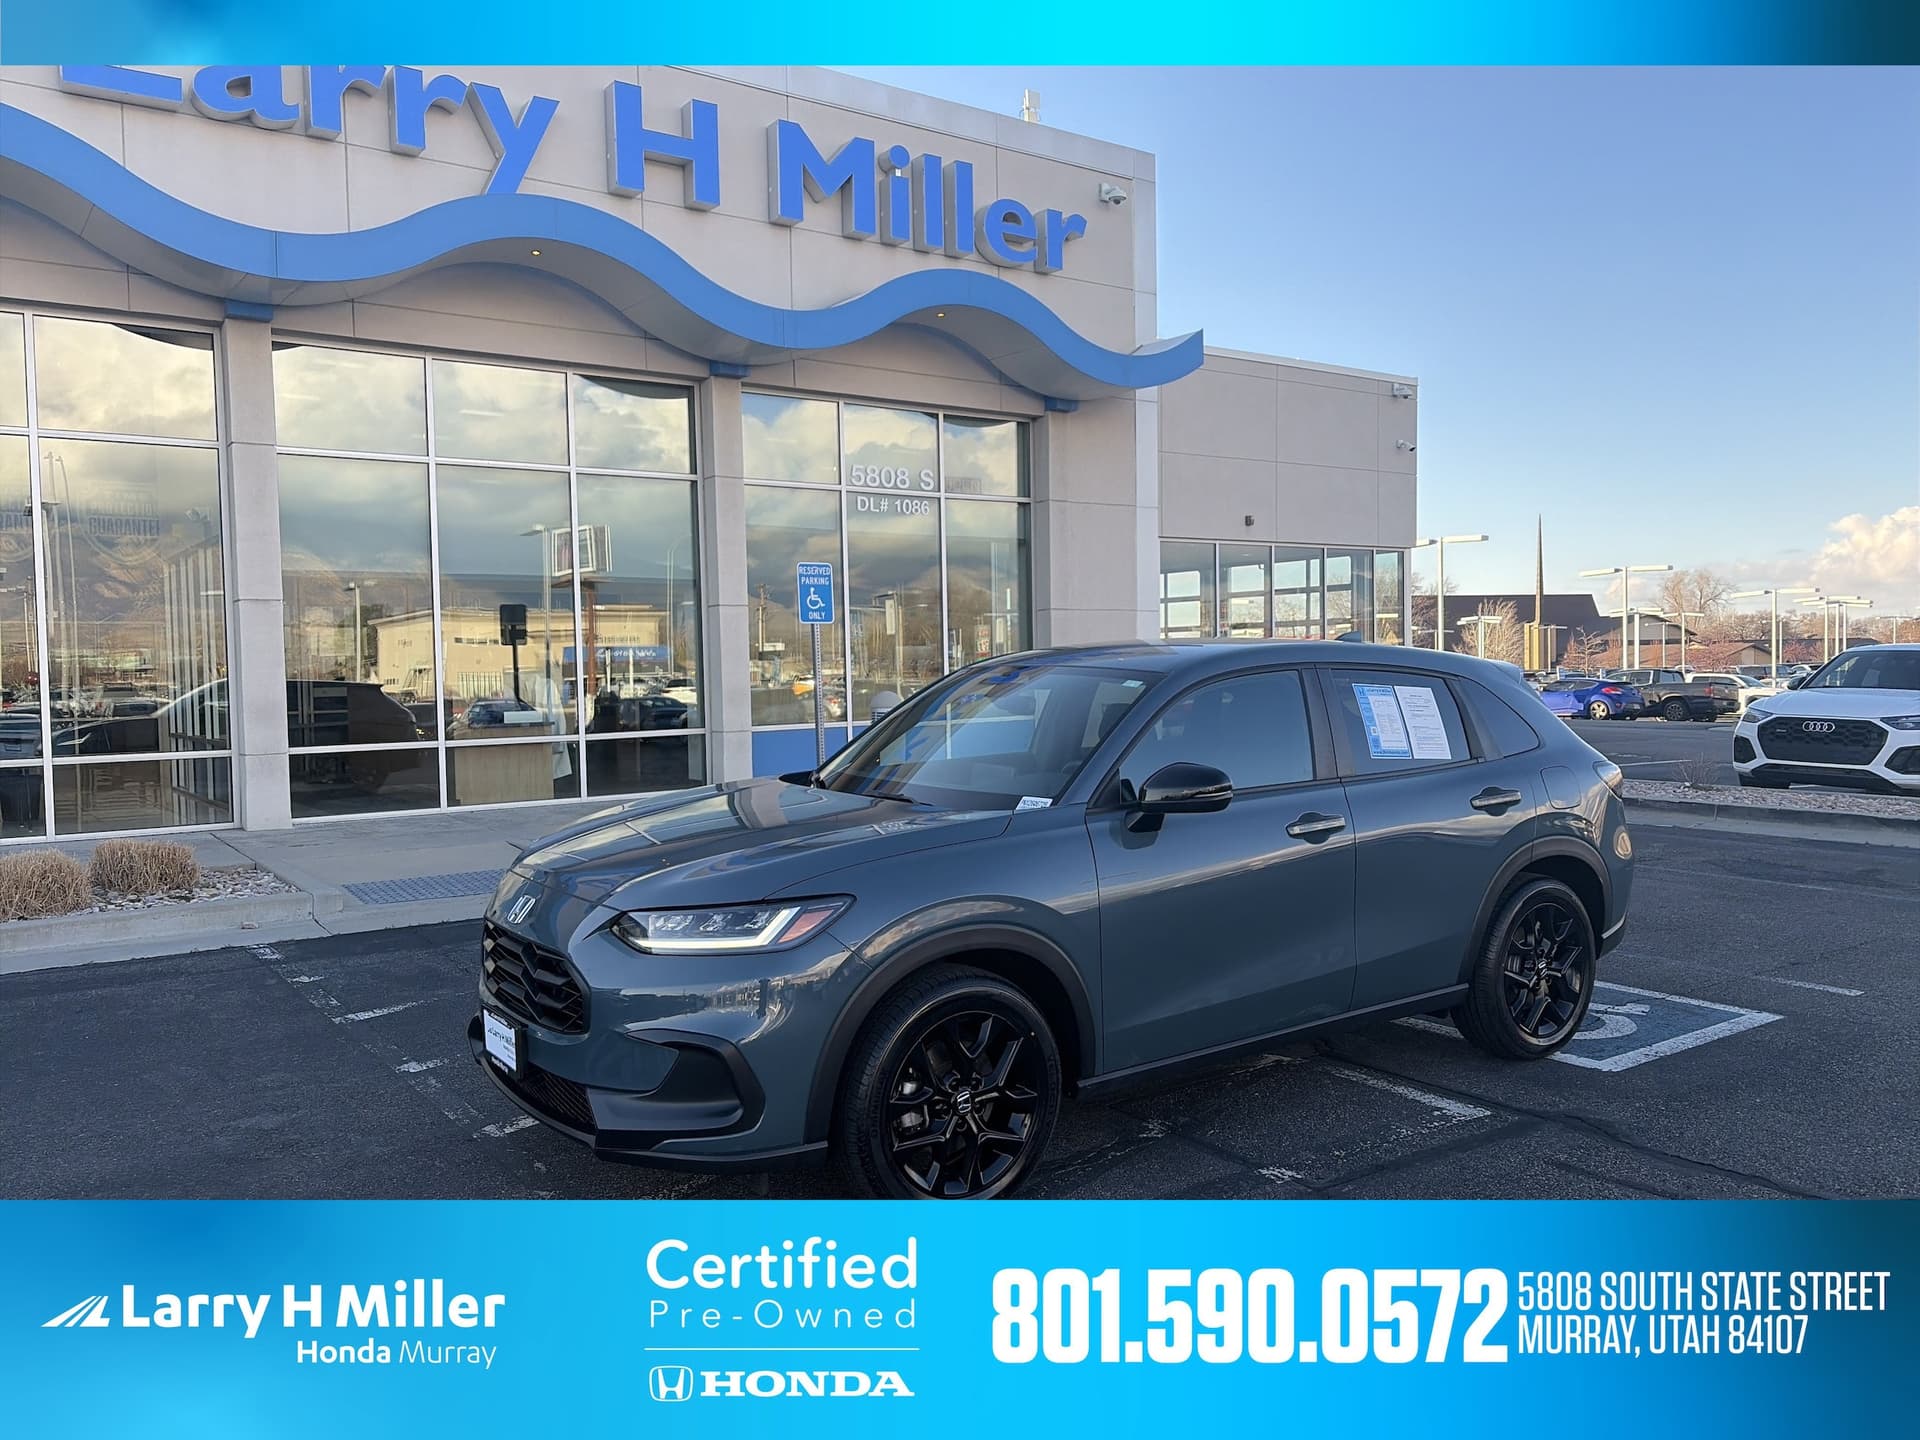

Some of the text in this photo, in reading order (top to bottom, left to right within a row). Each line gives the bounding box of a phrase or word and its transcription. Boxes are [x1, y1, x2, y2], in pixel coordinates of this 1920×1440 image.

[605, 80, 720, 211] H
[767, 118, 1087, 274] Miller
[851, 464, 910, 489] 5808
[919, 469, 935, 491] S
[857, 496, 930, 515] DL# 1086
[799, 566, 831, 576] RESERVED
[801, 577, 830, 585] PARKING
[809, 611, 826, 620] ONLY
